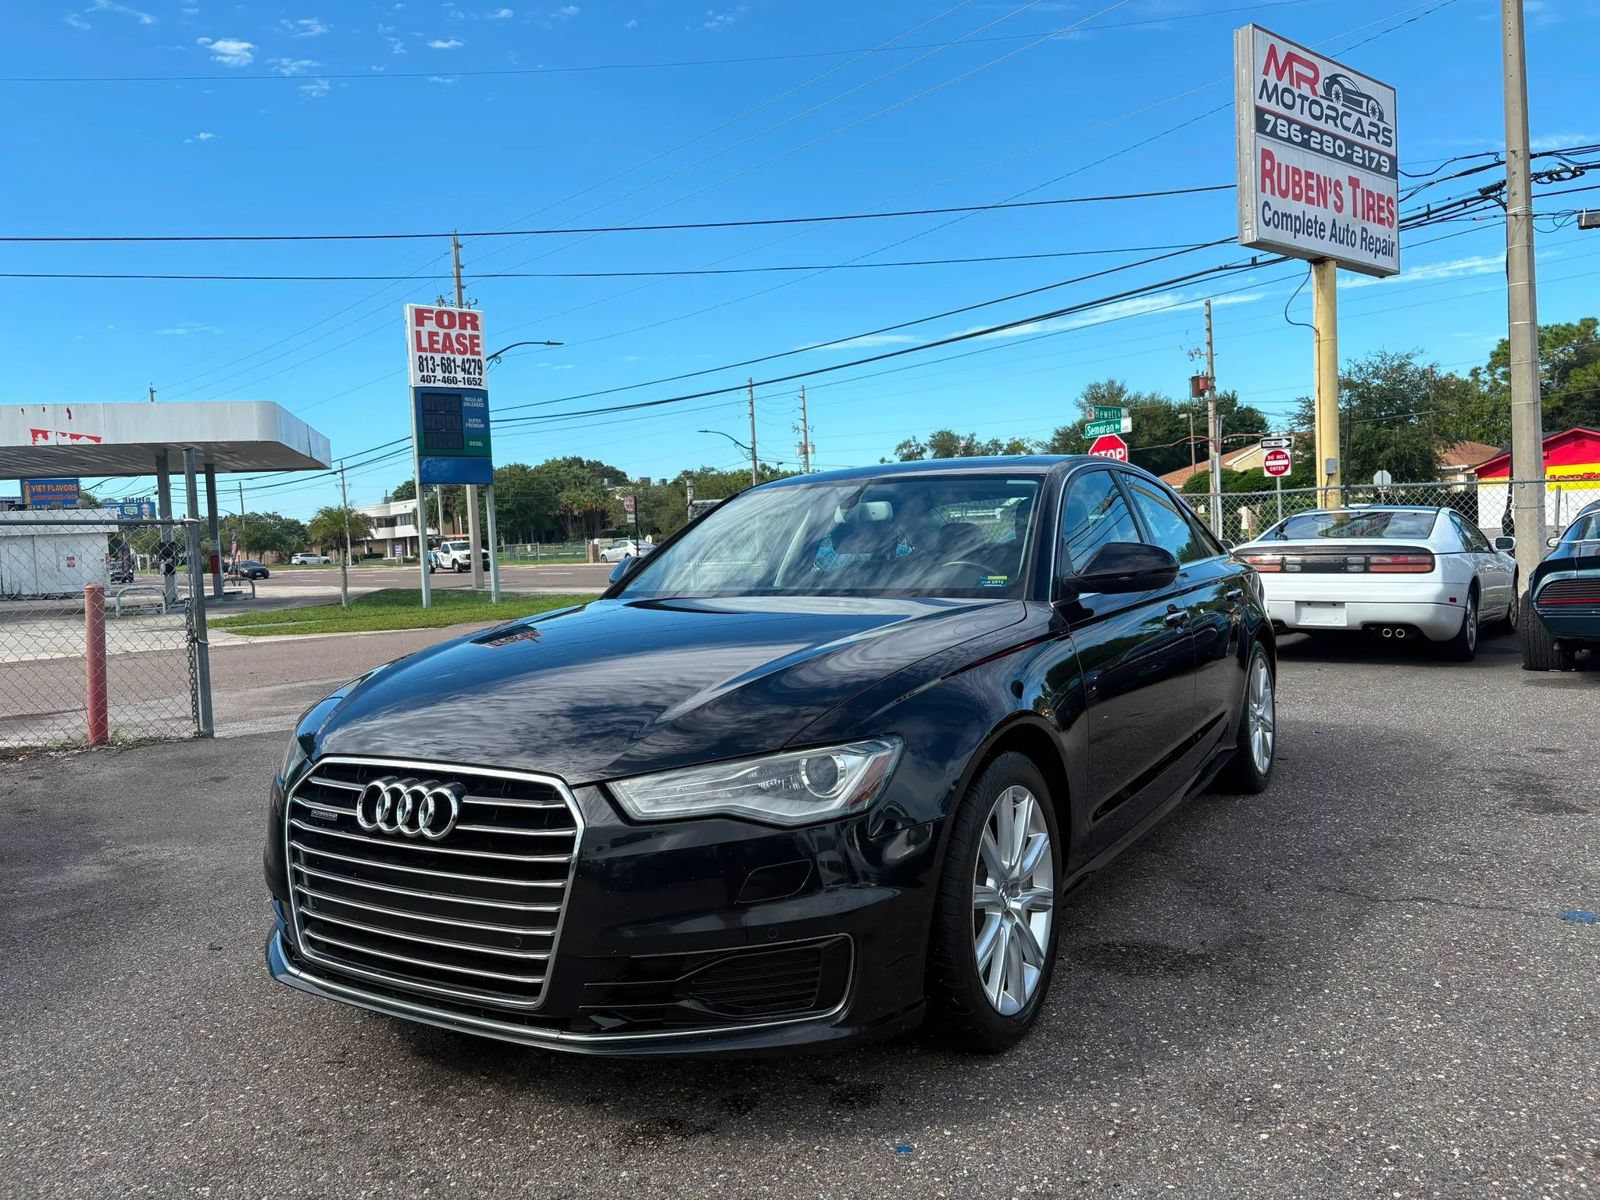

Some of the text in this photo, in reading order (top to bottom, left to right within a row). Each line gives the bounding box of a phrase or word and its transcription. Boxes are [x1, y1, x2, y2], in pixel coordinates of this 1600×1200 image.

[1262, 43, 1321, 97] MR
[1258, 79, 1393, 148] MOTORCARS
[1263, 113, 1390, 173] 786-280-2179
[1260, 148, 1395, 229] RUBEN'S TIRES
[1261, 200, 1396, 259] Complete Auto Repair
[414, 308, 480, 331] FOR
[415, 330, 481, 357] LEASE
[418, 355, 483, 376] 813-681-4279
[420, 374, 483, 387] 407-460-1652
[1086, 424, 1115, 437] Semoran
[30, 484, 77, 492] VIET FLAVORS
